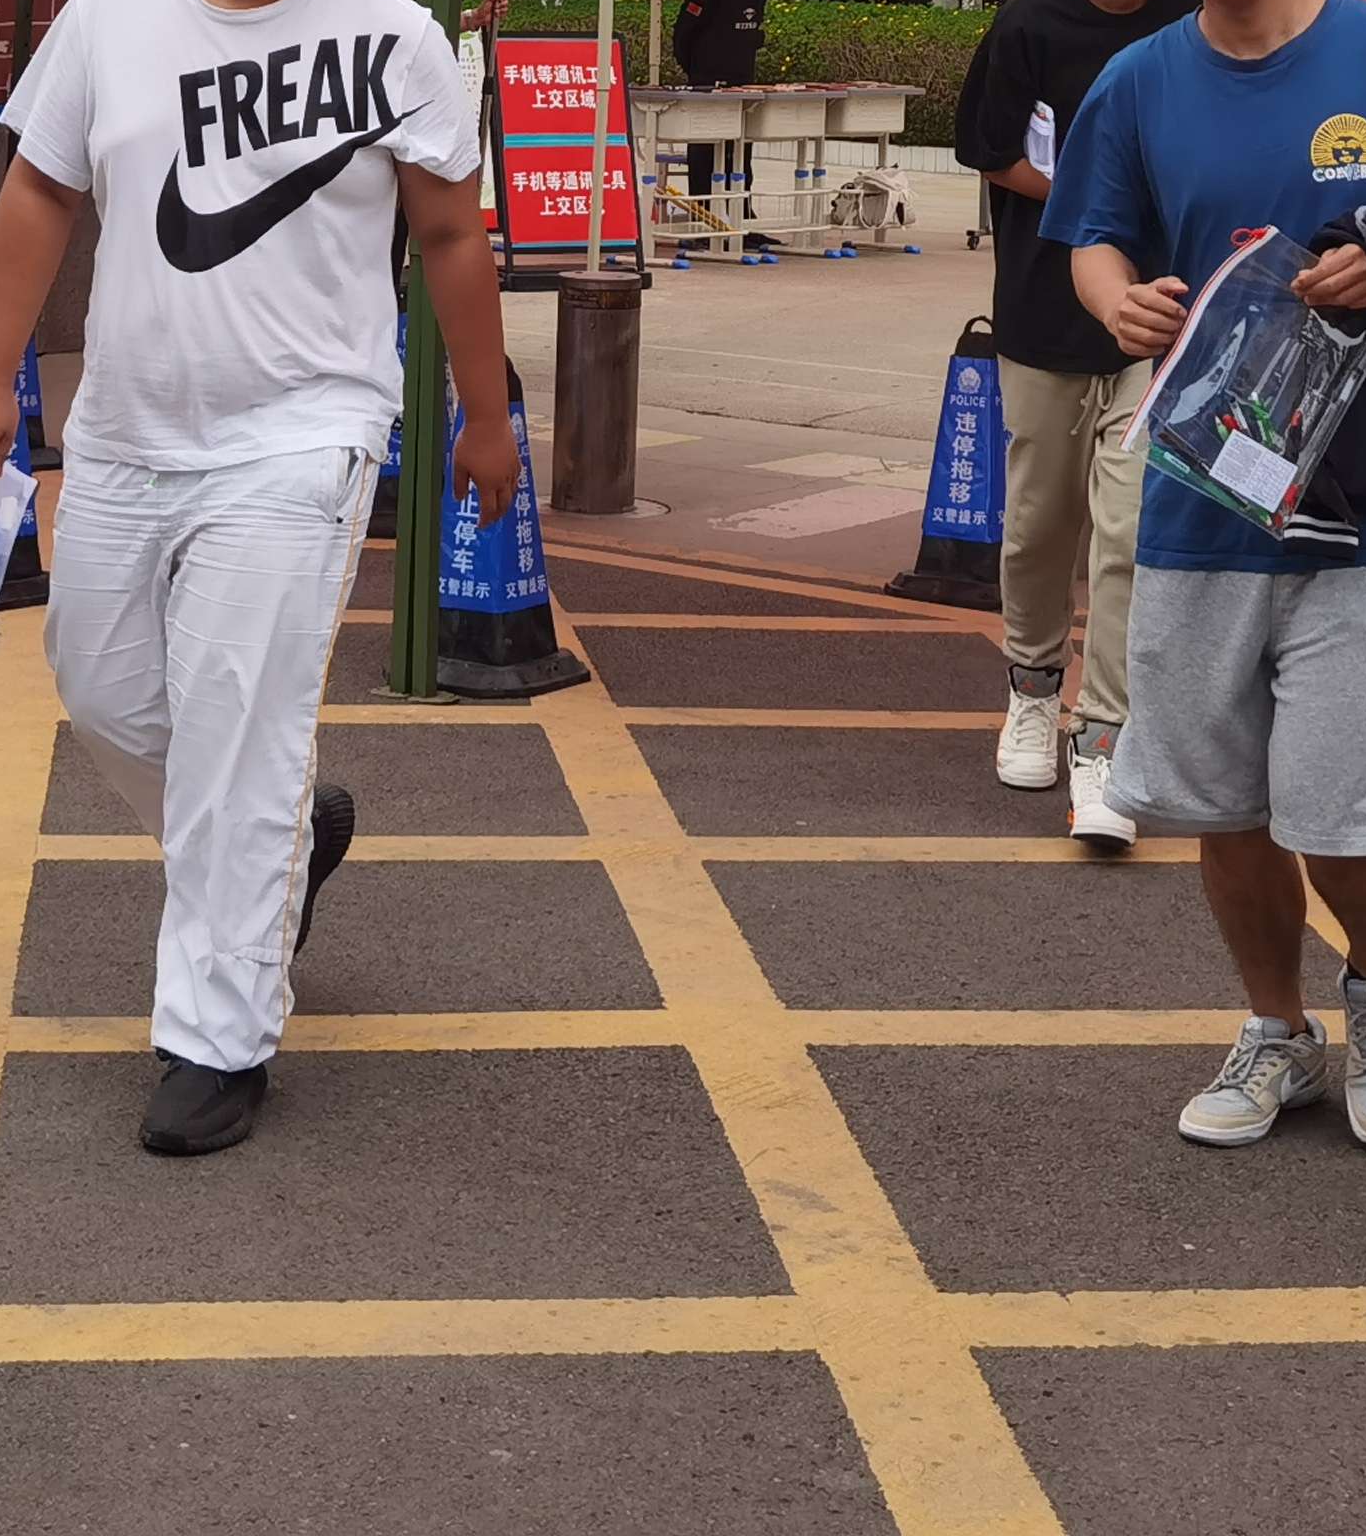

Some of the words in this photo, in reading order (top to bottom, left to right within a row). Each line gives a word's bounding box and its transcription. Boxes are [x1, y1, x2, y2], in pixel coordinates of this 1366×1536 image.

[179, 33, 401, 169] FREAK
[950, 394, 986, 408] POLICE
[948, 411, 977, 504] 违停拖移
[452, 476, 480, 575] 止停车
[932, 507, 987, 526] 交警提示
